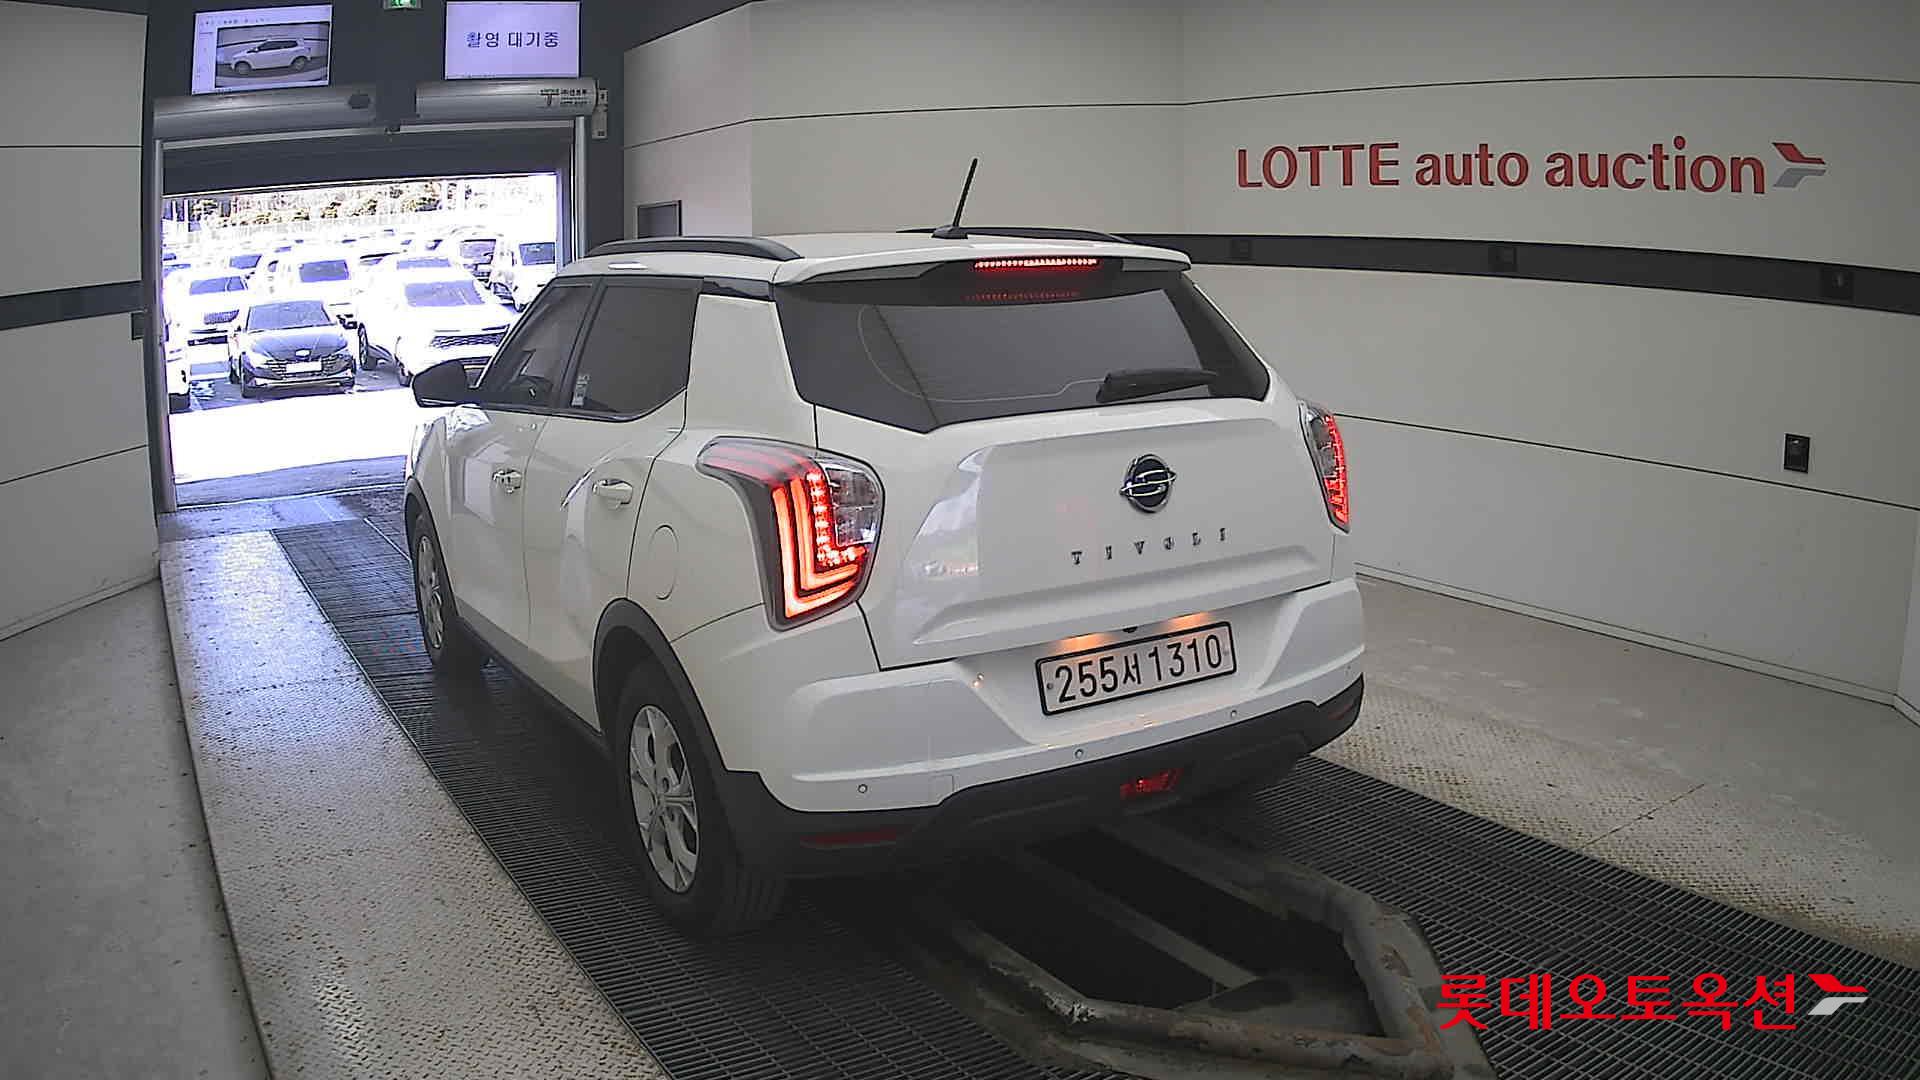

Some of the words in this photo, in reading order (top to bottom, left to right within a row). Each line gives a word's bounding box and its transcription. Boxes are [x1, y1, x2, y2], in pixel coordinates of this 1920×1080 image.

[466, 31, 500, 48] 촬영
[507, 31, 560, 48] 대기중
[1236, 141, 1400, 189] LOTTE
[1414, 142, 1530, 188] auto
[1544, 135, 1766, 195] auction
[1070, 526, 1227, 566] TIVOLI
